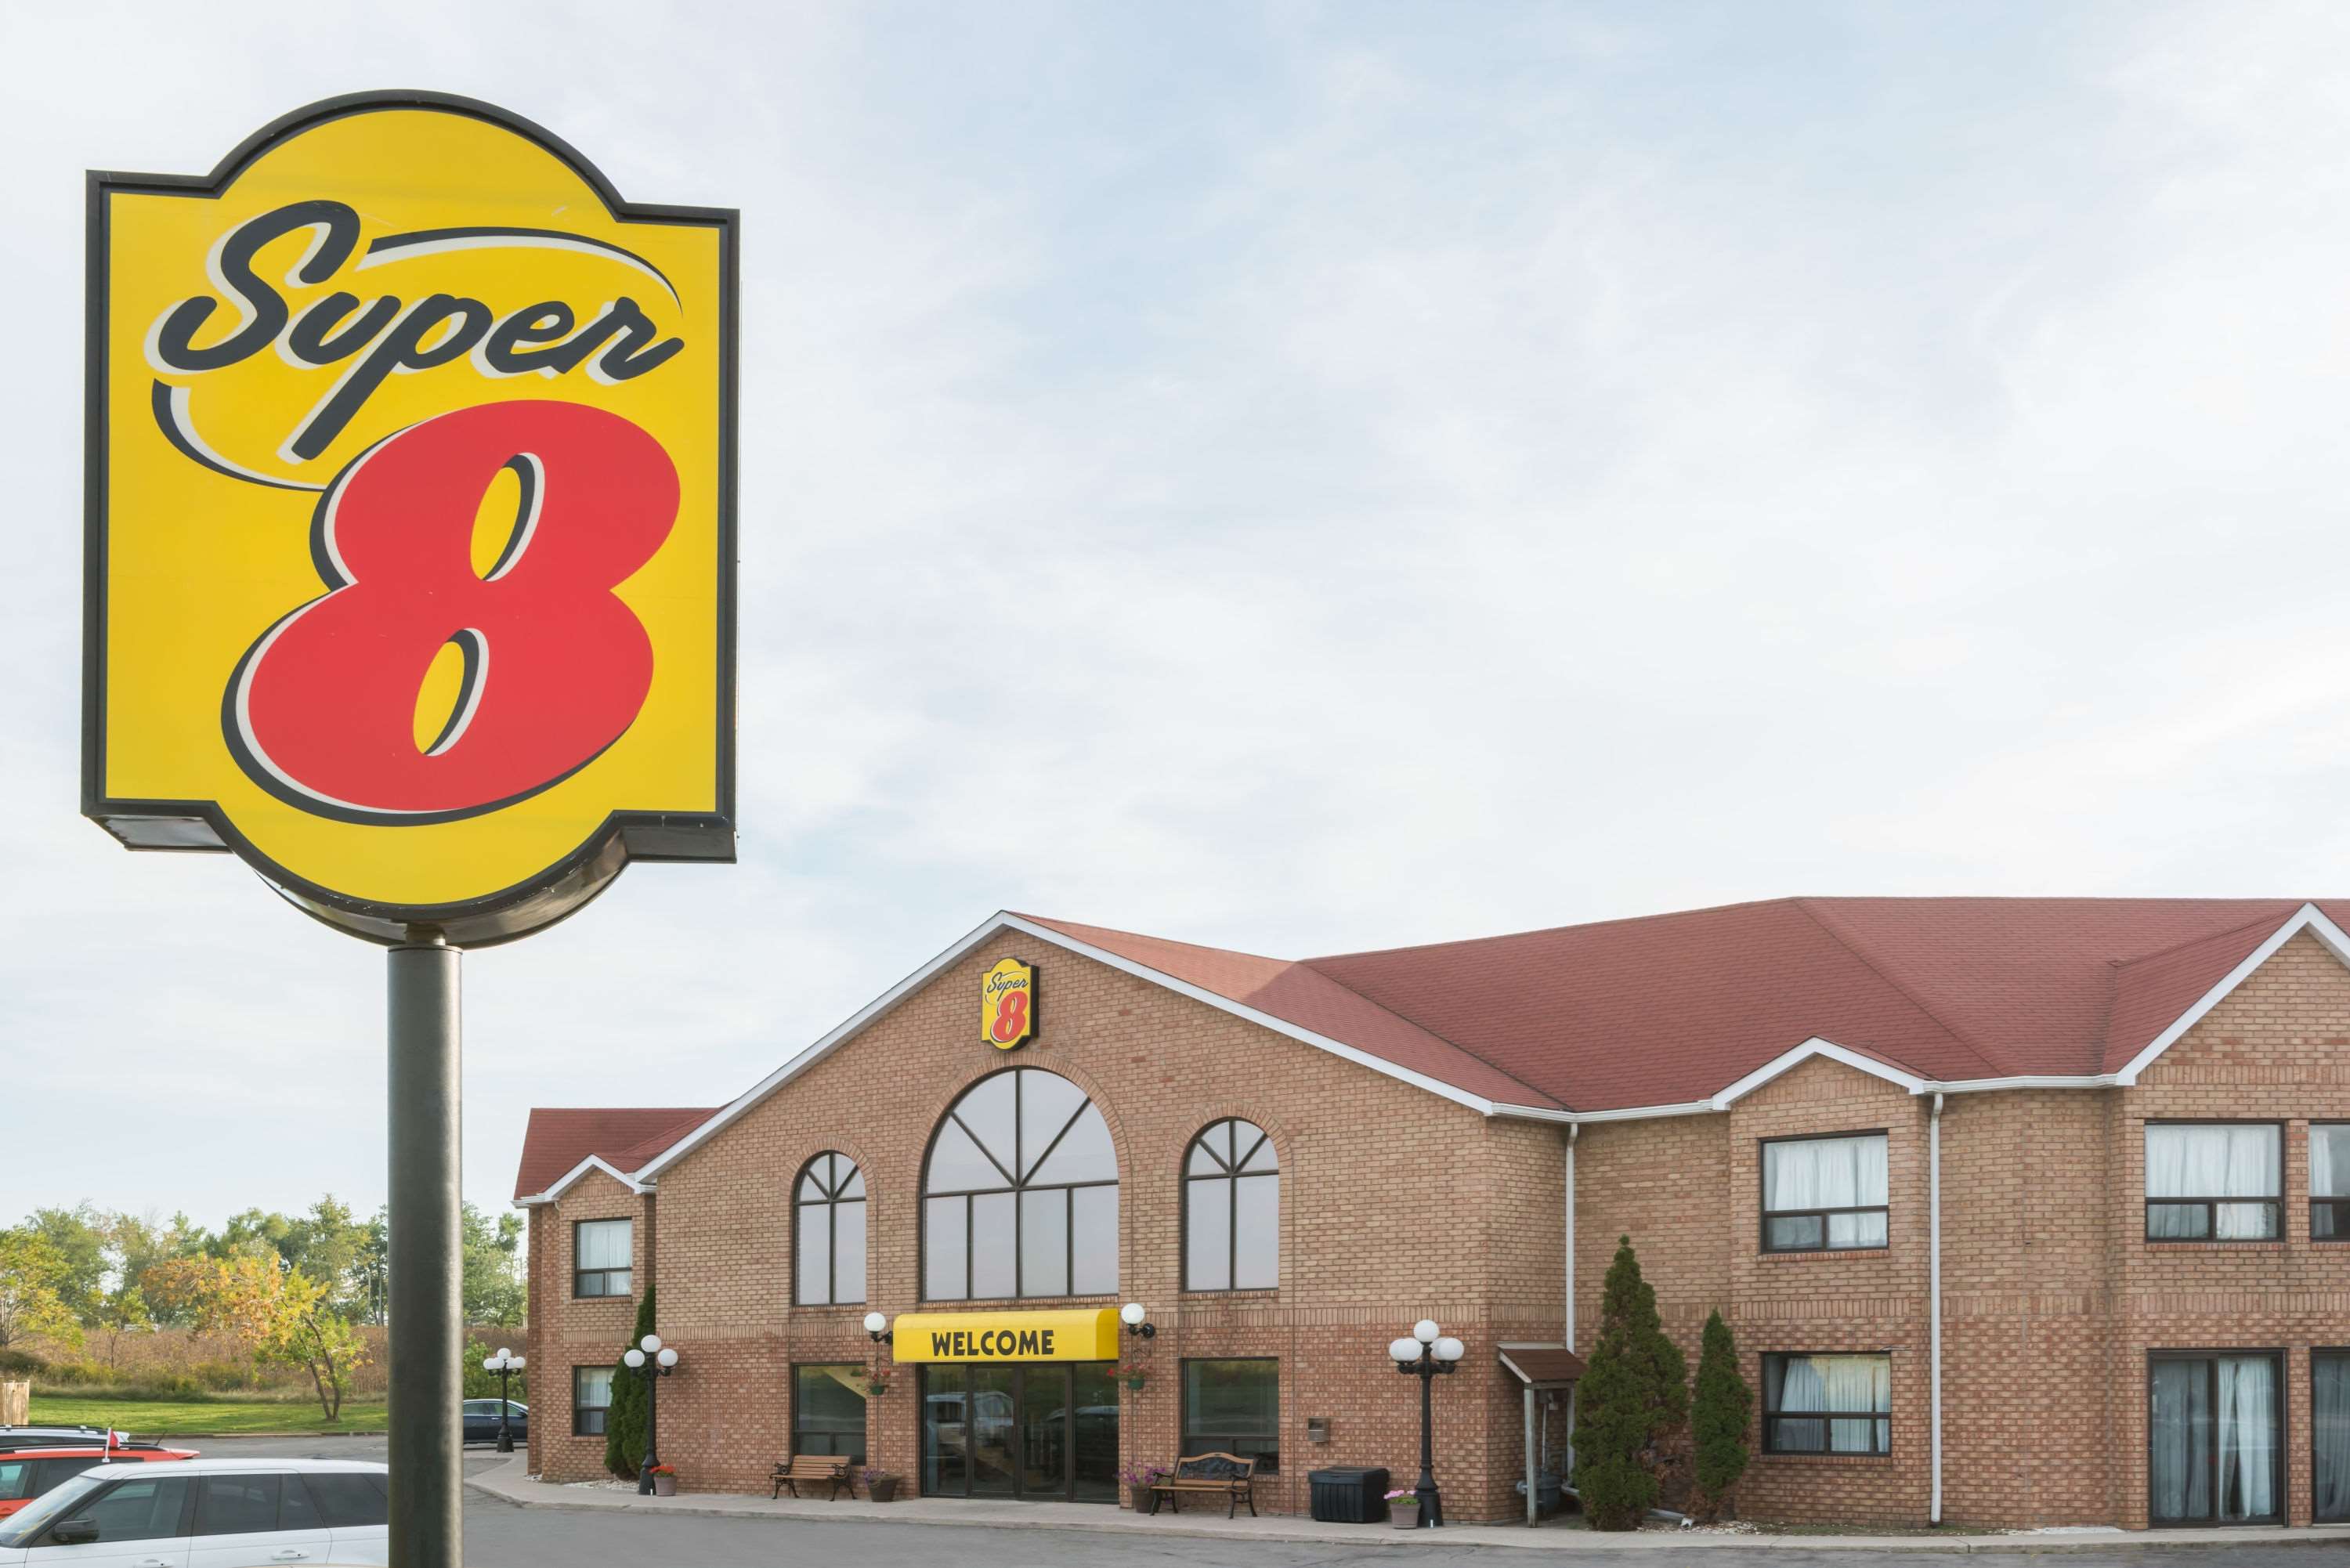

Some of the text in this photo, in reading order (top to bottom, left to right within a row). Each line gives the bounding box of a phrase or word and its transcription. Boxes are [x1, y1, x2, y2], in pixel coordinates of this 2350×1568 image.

[145, 200, 685, 464] Super
[222, 400, 680, 826] 8
[986, 971, 1029, 1002] Super
[990, 991, 1028, 1042] 8
[931, 1330, 1054, 1356] WELCOME
